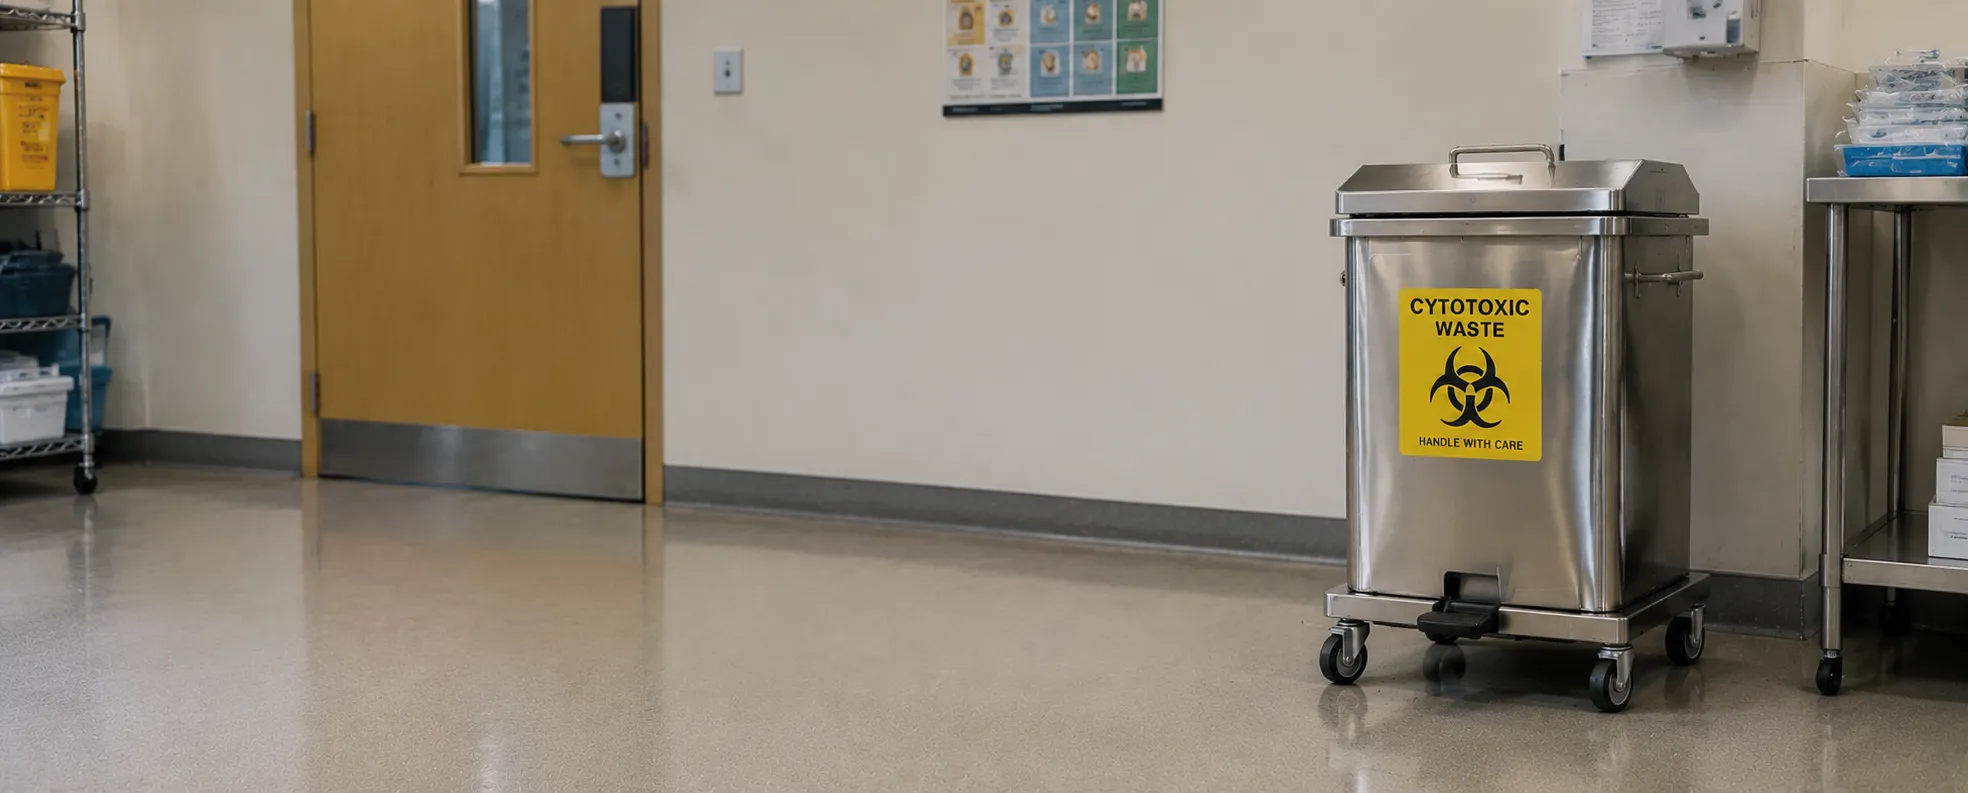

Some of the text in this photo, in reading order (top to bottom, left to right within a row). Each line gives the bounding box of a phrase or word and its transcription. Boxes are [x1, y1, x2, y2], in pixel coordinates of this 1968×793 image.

[1410, 298, 1530, 316] CYTOTOXIC
[1435, 321, 1505, 338] WASTE
[1419, 436, 1524, 451] HANDLE WITH CARE
